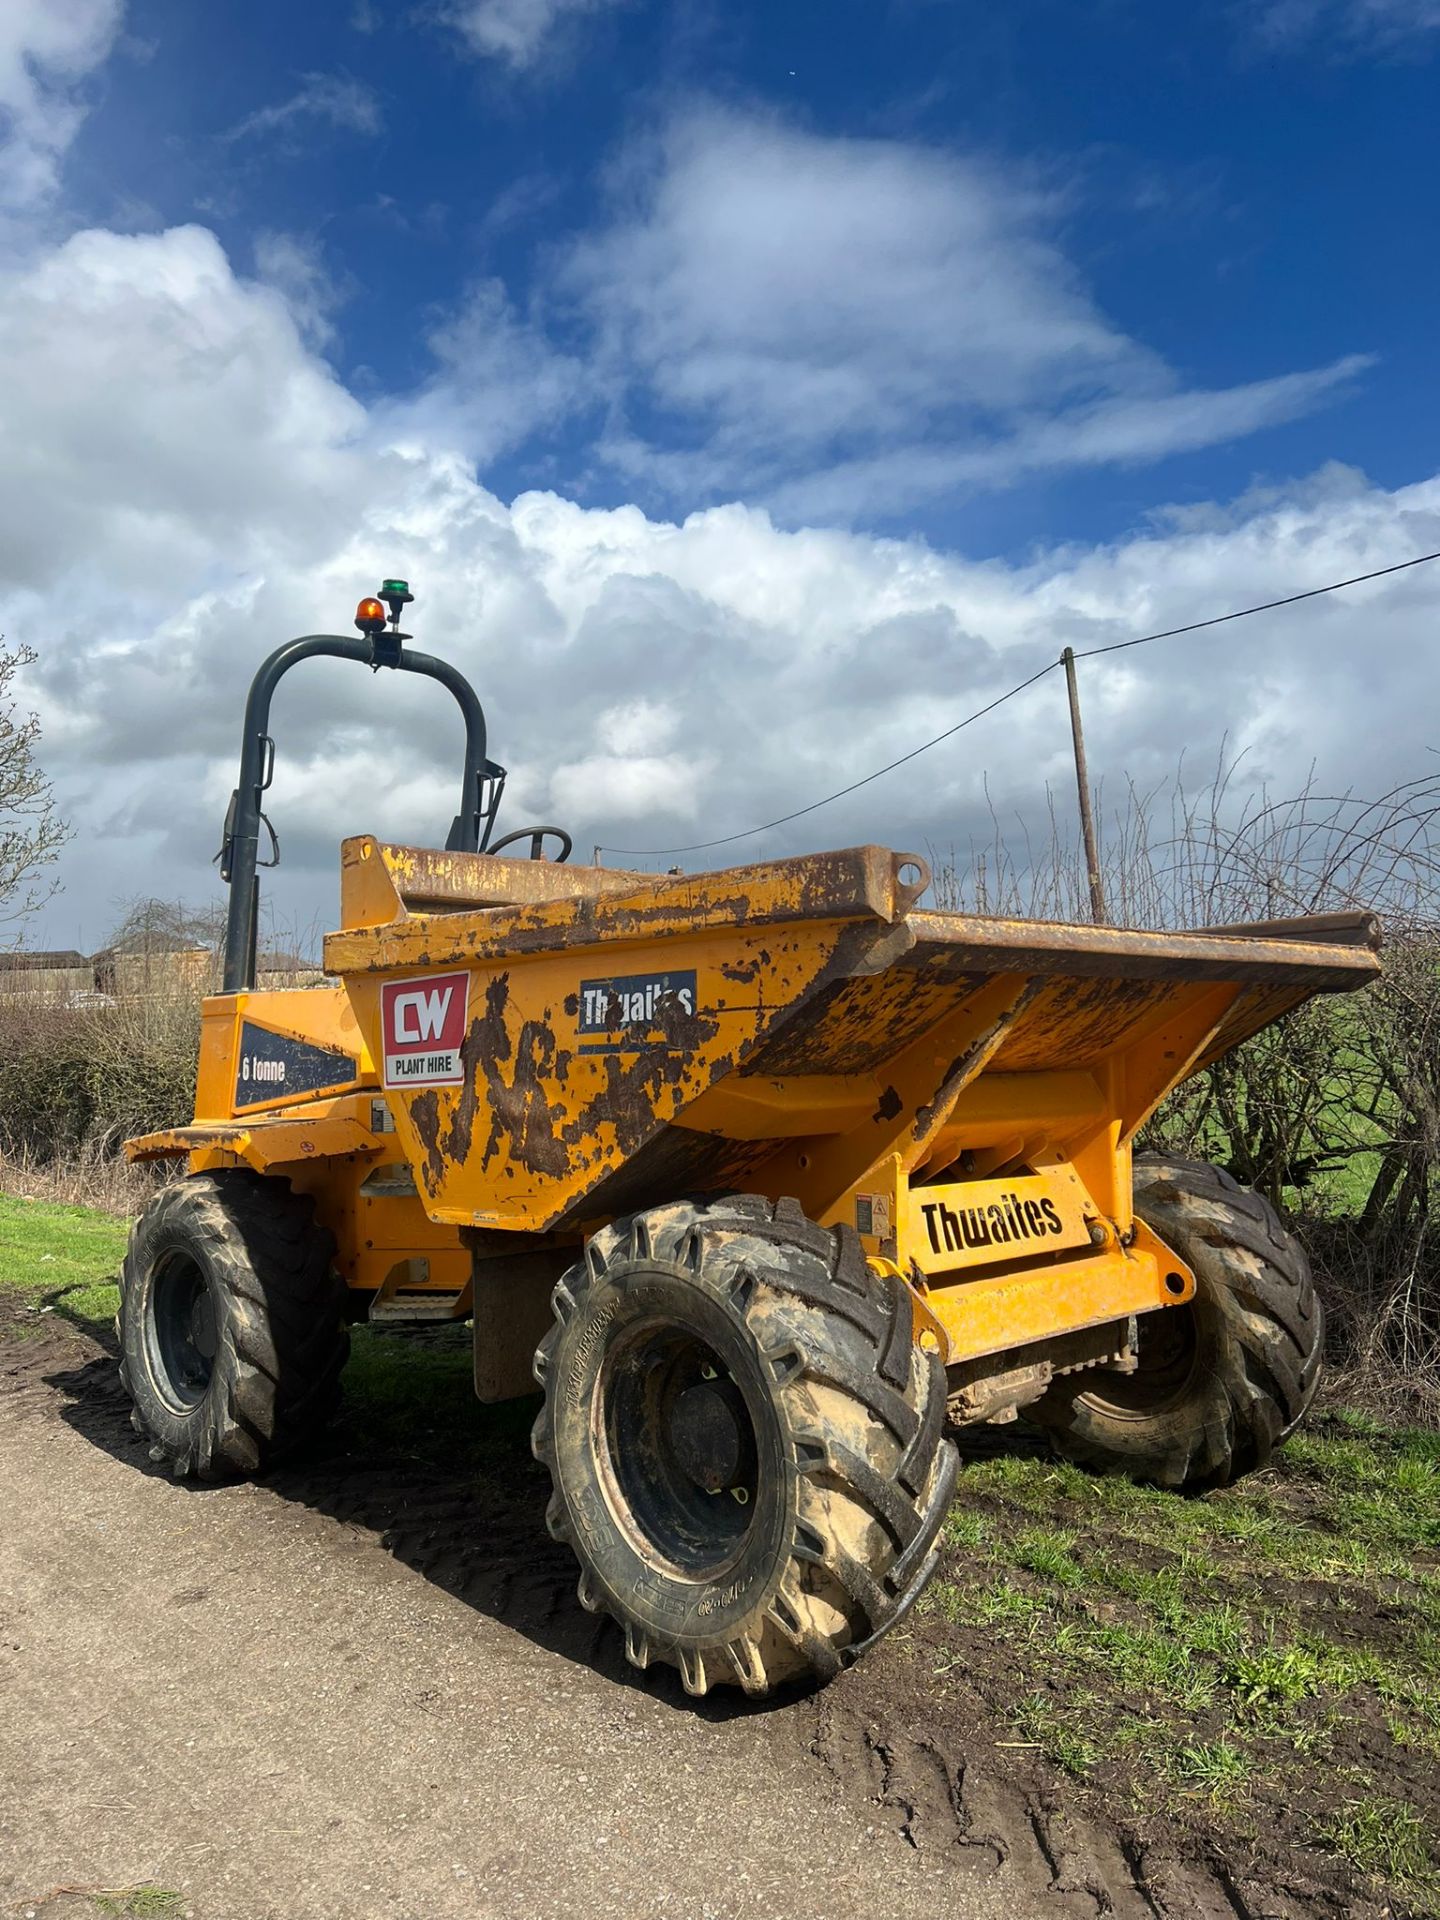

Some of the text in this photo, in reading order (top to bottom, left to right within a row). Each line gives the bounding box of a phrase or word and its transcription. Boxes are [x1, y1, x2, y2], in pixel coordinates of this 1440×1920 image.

[394, 987, 453, 1044] CW
[242, 1055, 286, 1082] 6 tonne
[396, 1056, 452, 1076] PLANT HIRE
[920, 1193, 1063, 1255] Thwaites
